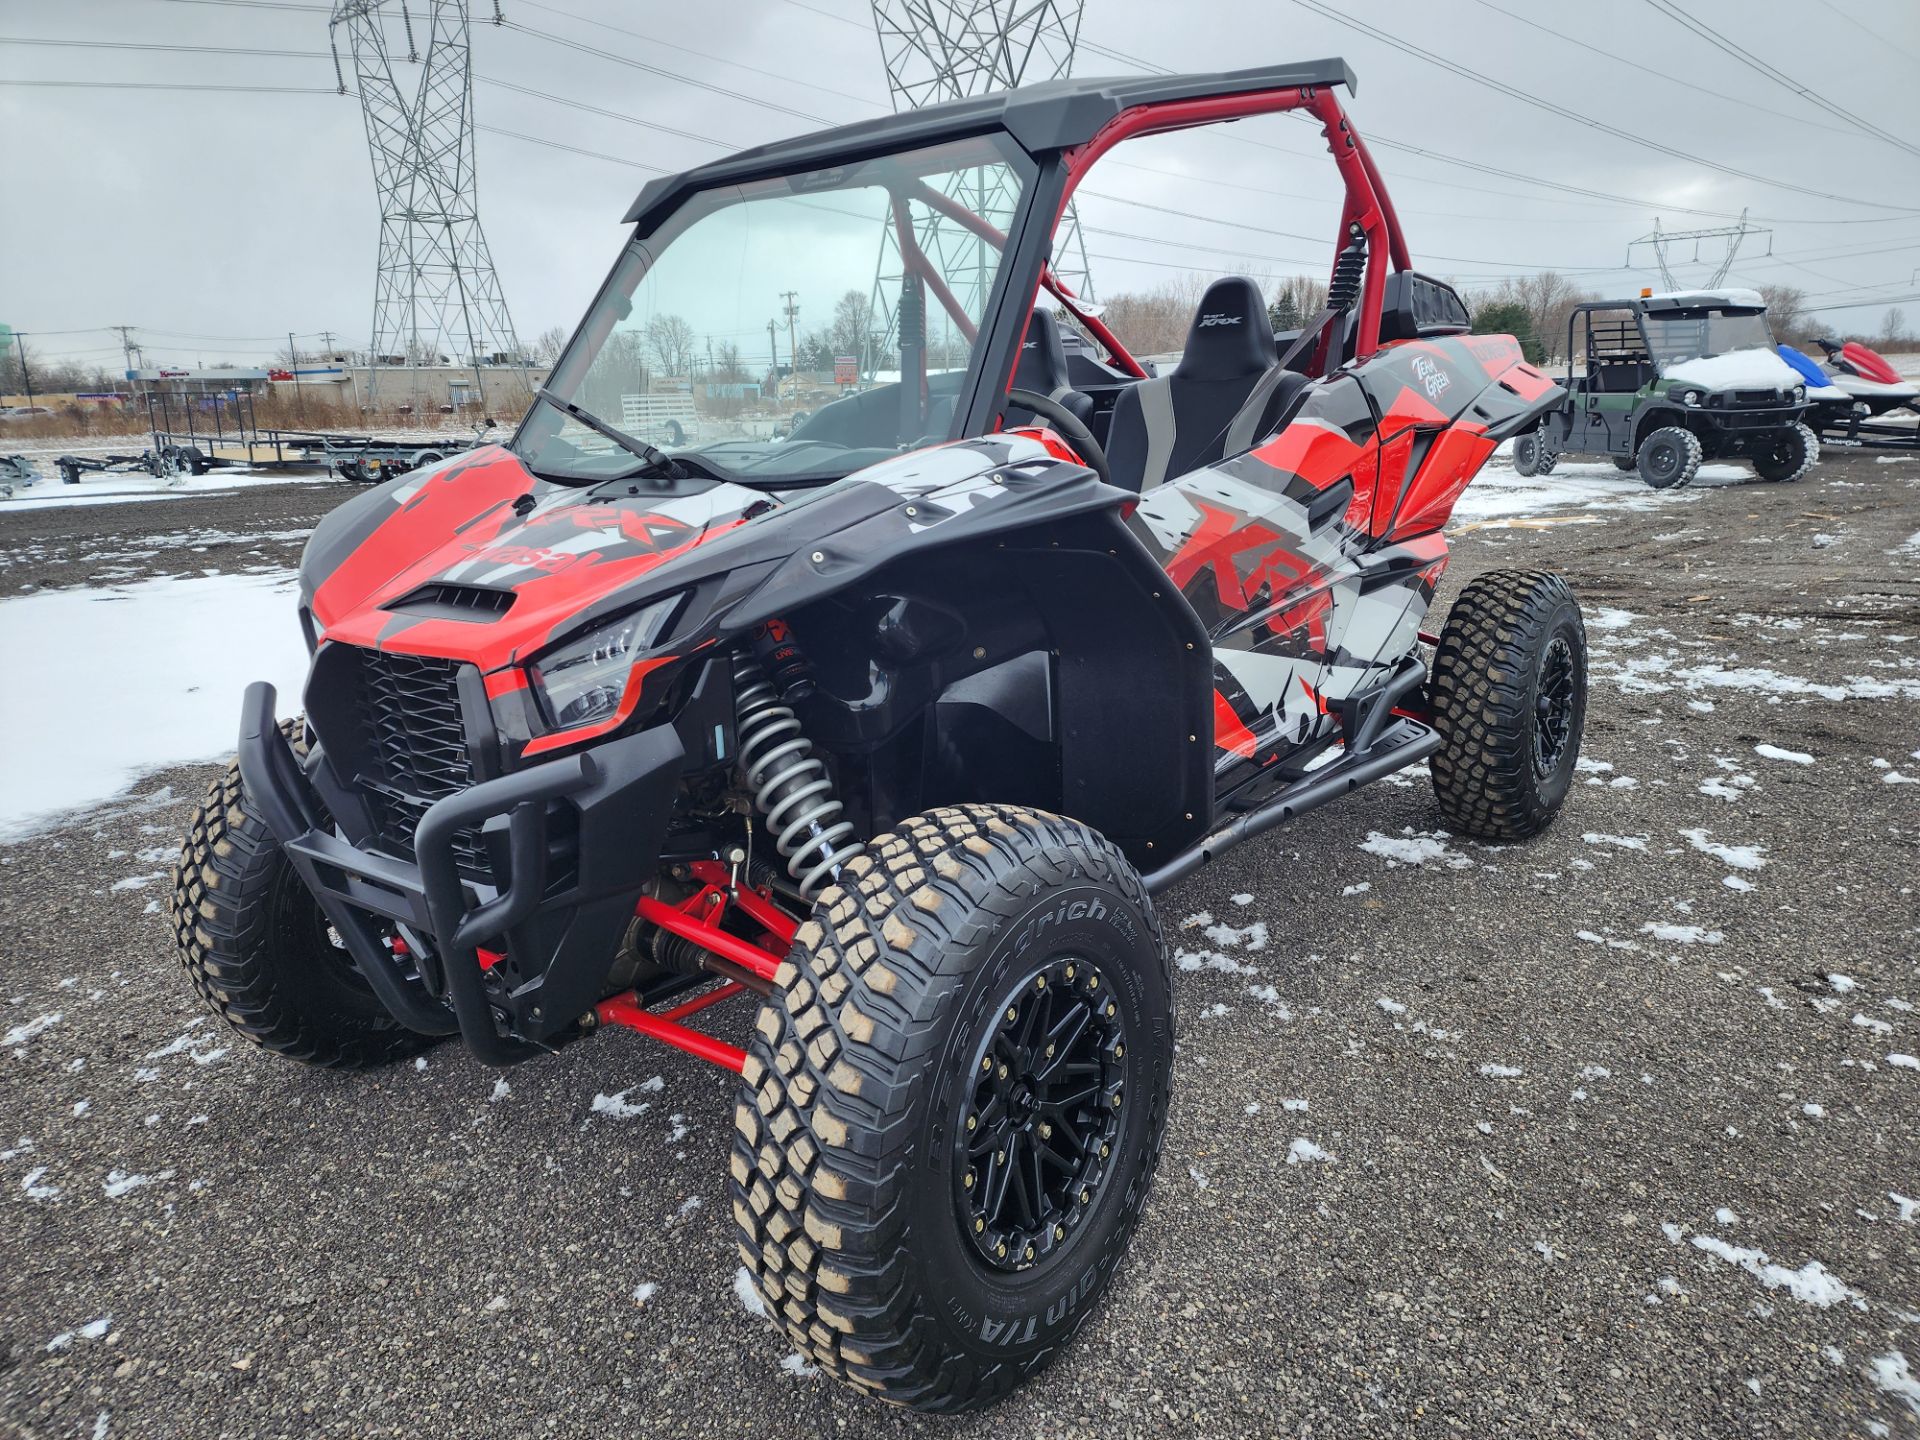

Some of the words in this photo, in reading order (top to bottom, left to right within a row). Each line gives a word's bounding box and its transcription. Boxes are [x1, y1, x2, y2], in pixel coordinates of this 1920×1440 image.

[1198, 316, 1244, 328] KRX
[1411, 356, 1438, 381] TEAM
[1425, 371, 1451, 400] GREEN
[978, 1314, 1041, 1346] T/A
